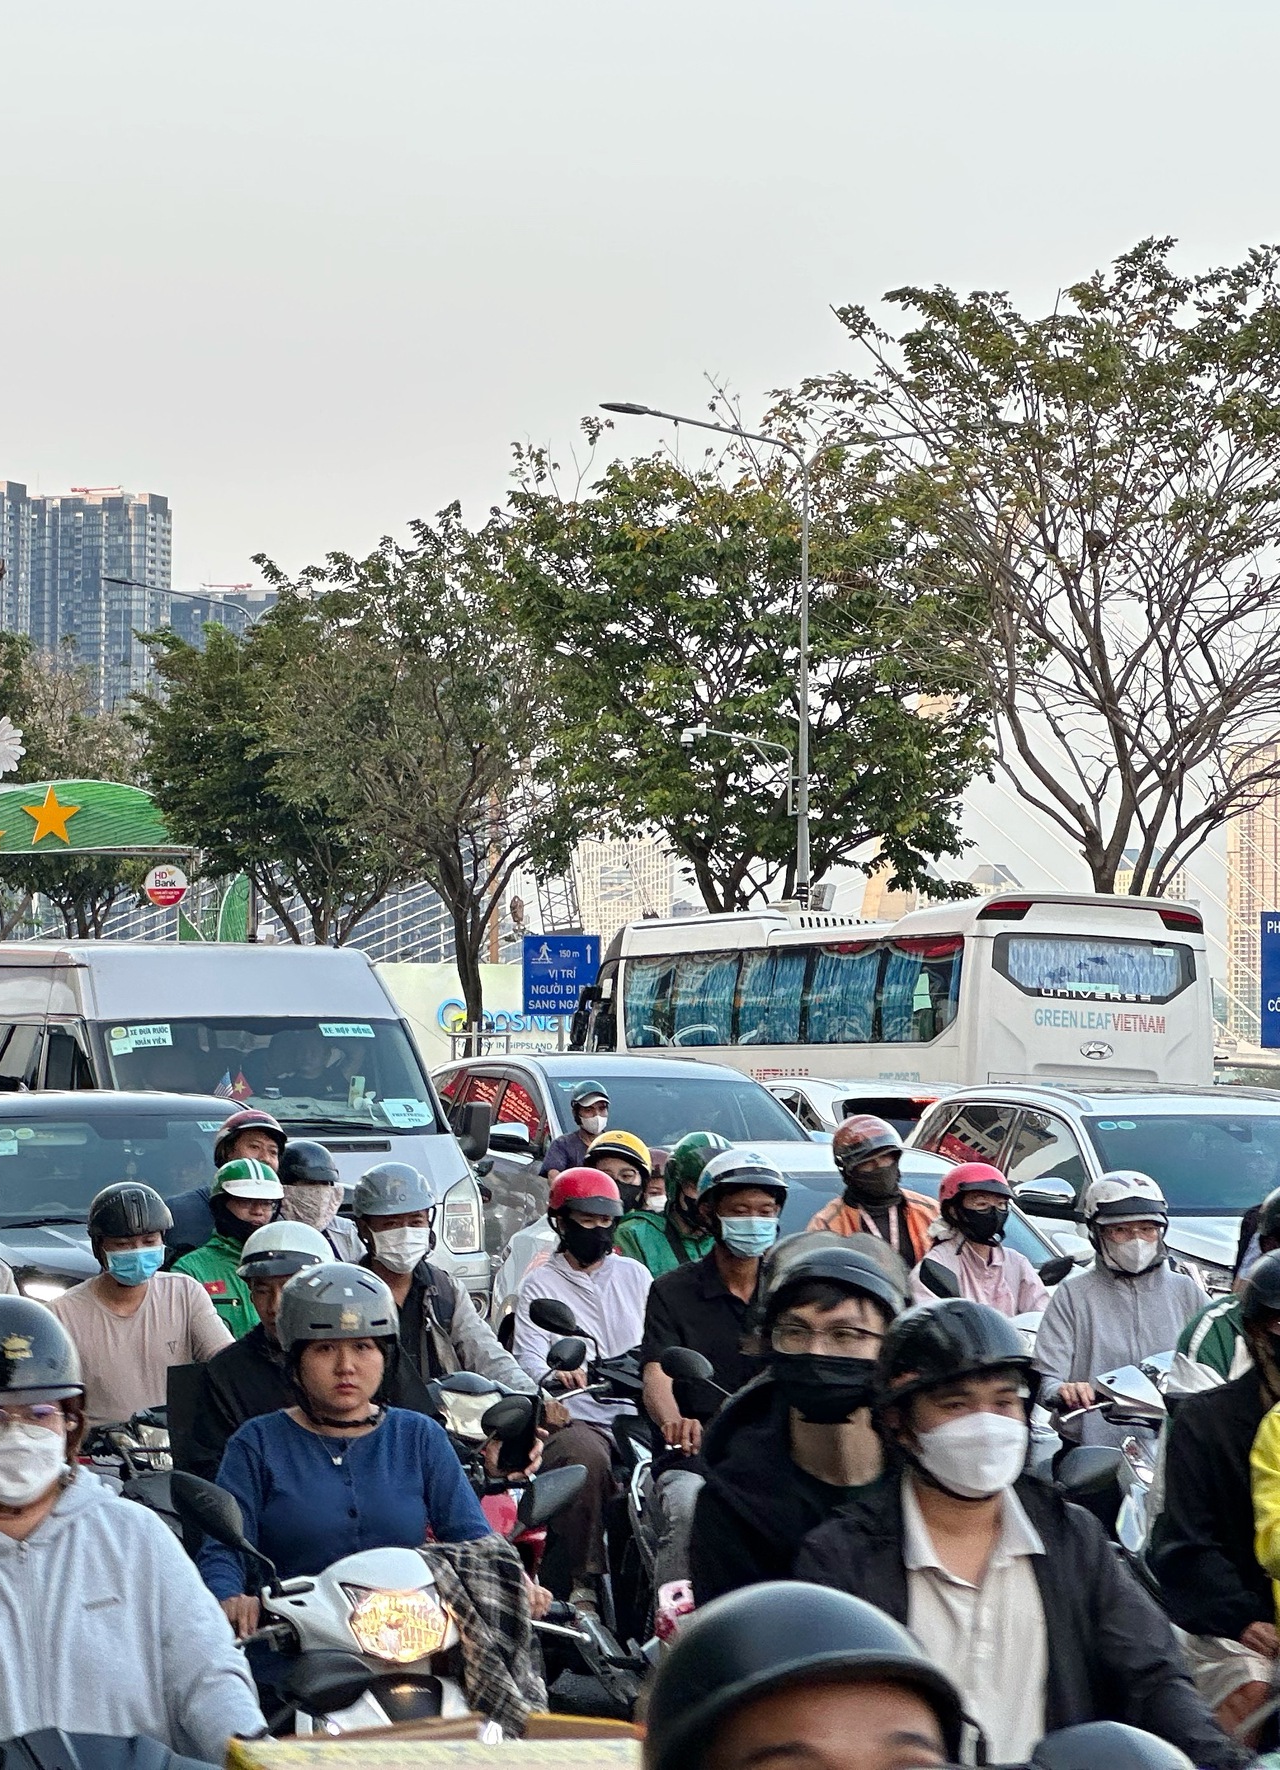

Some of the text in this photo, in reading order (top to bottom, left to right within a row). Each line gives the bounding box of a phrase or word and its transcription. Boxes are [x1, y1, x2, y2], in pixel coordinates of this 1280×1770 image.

[154, 871, 168, 880] HD
[154, 879, 176, 888] Bank
[558, 949, 571, 958] 150
[548, 966, 577, 981] VỊ TRÍ
[531, 982, 563, 995] NGƯỜI
[565, 985, 576, 995] ĐI
[528, 1000, 556, 1010] SANG
[1034, 1008, 1078, 1029] GREEN
[1112, 1013, 1166, 1034] VIETNAM
[130, 1028, 138, 1036] XE
